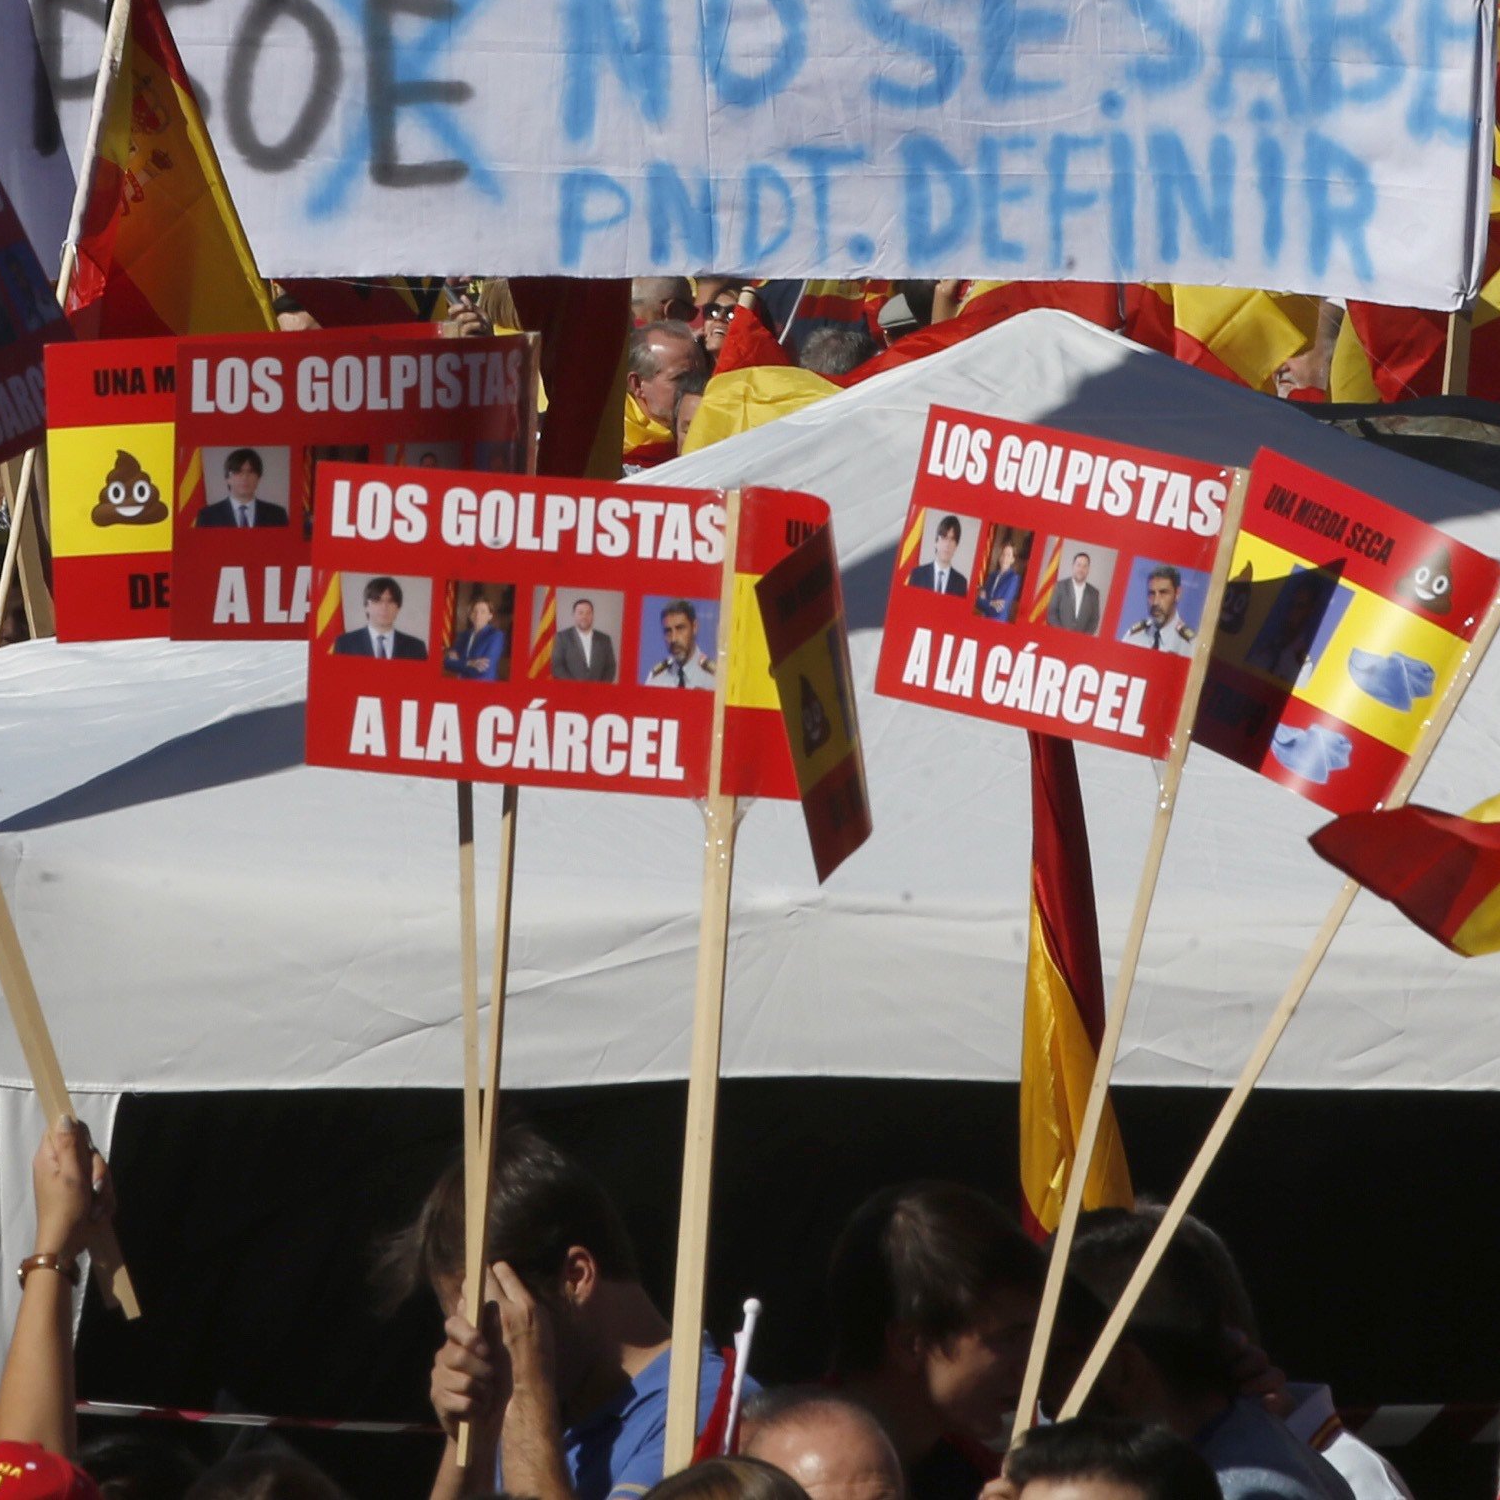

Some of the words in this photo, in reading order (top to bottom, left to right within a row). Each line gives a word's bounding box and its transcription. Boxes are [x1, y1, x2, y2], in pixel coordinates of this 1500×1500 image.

[93, 368, 148, 397] UNA
[190, 355, 284, 415] LOS
[296, 347, 523, 414] GOLPISTAS
[927, 419, 994, 486] LOS
[993, 433, 1228, 538] GOLPISTAS
[329, 479, 429, 544] LOS
[440, 485, 727, 565] GOLPISTAS
[1263, 483, 1299, 520] UNA
[1291, 496, 1351, 544] MIERDA
[1344, 521, 1397, 566] SECA
[128, 573, 171, 611] DE
[212, 565, 251, 625] A
[902, 626, 933, 689] A
[933, 632, 979, 699] LA
[981, 641, 1148, 739] CÁRCEL
[348, 695, 388, 758] A
[399, 697, 464, 765] LA
[476, 697, 686, 782] CÁRCEL
